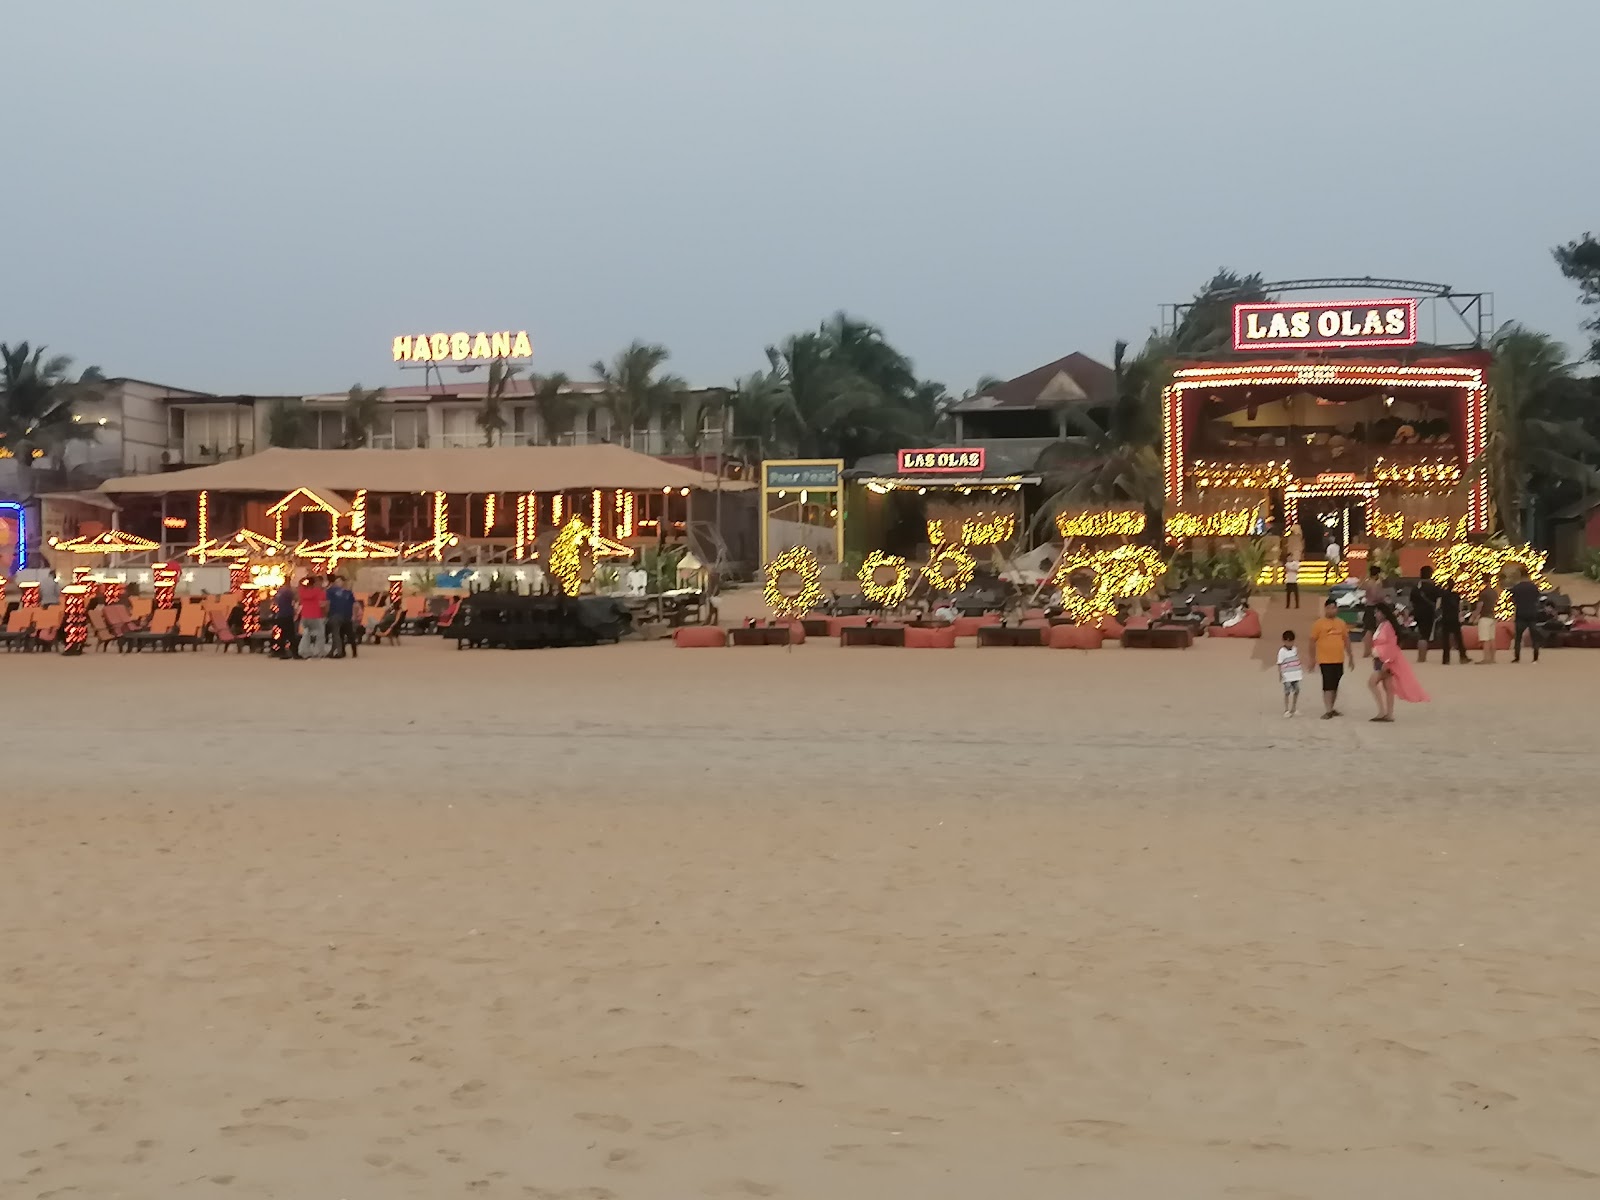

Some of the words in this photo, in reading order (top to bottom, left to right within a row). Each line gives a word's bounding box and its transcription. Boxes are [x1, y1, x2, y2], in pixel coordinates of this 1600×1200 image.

[1246, 310, 1311, 339] LAS
[1317, 308, 1406, 337] OLAS
[392, 330, 533, 362] HABBANA
[904, 453, 935, 468] LAS
[937, 452, 980, 467] OLAS
